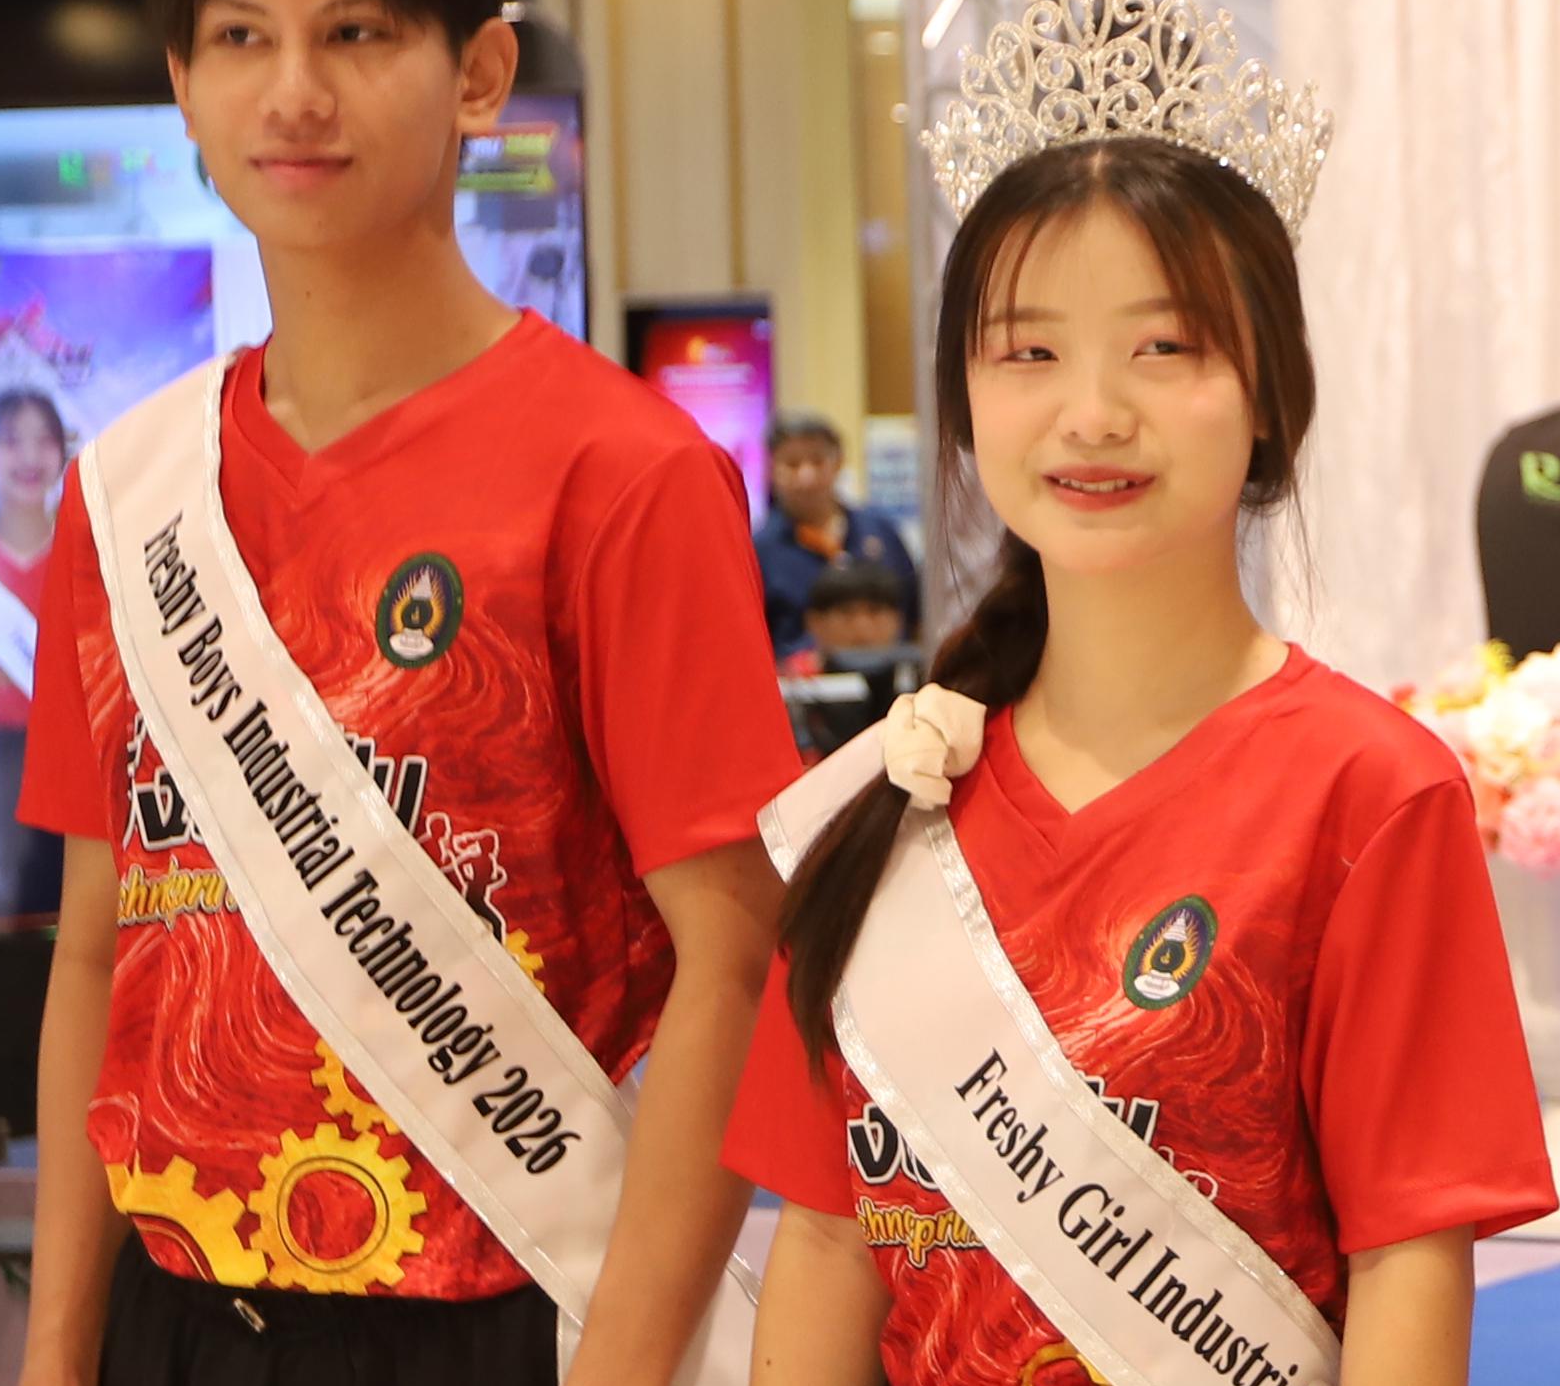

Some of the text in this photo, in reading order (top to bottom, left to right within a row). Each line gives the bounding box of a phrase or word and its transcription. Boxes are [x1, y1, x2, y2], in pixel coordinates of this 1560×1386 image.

[144, 509, 207, 636] Freshy
[178, 614, 242, 721] Boys
[222, 699, 354, 892] Industrial
[321, 868, 502, 1085] Technology
[472, 1066, 582, 1176] 2026
[954, 1048, 1064, 1203] Freshy
[1057, 1182, 1153, 1282] Girl
